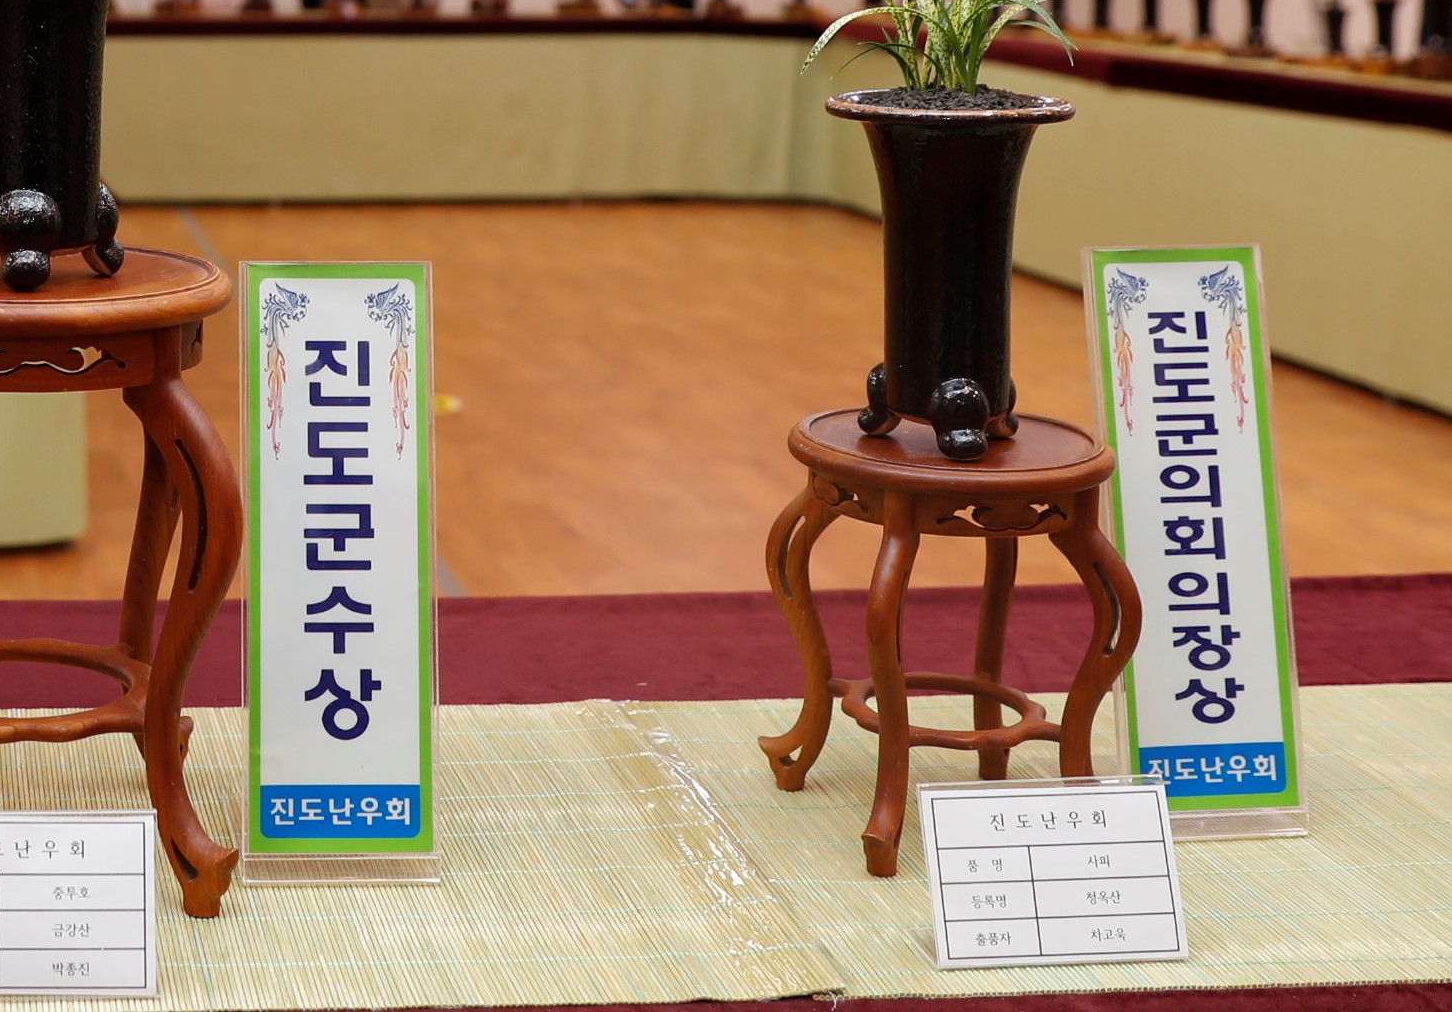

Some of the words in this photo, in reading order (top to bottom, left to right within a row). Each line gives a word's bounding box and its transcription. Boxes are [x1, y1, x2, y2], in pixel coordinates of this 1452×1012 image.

[303, 340, 382, 741] 진도군수상
[1147, 754, 1277, 785] 진도난우회
[271, 797, 410, 825] 진도난우회
[1087, 854, 1111, 869] 사피
[52, 886, 90, 901] 중투호
[971, 893, 1007, 910] 등록명
[52, 922, 90, 938] 금강산
[974, 931, 1012, 947] 출품자
[52, 961, 90, 977] 박종진
